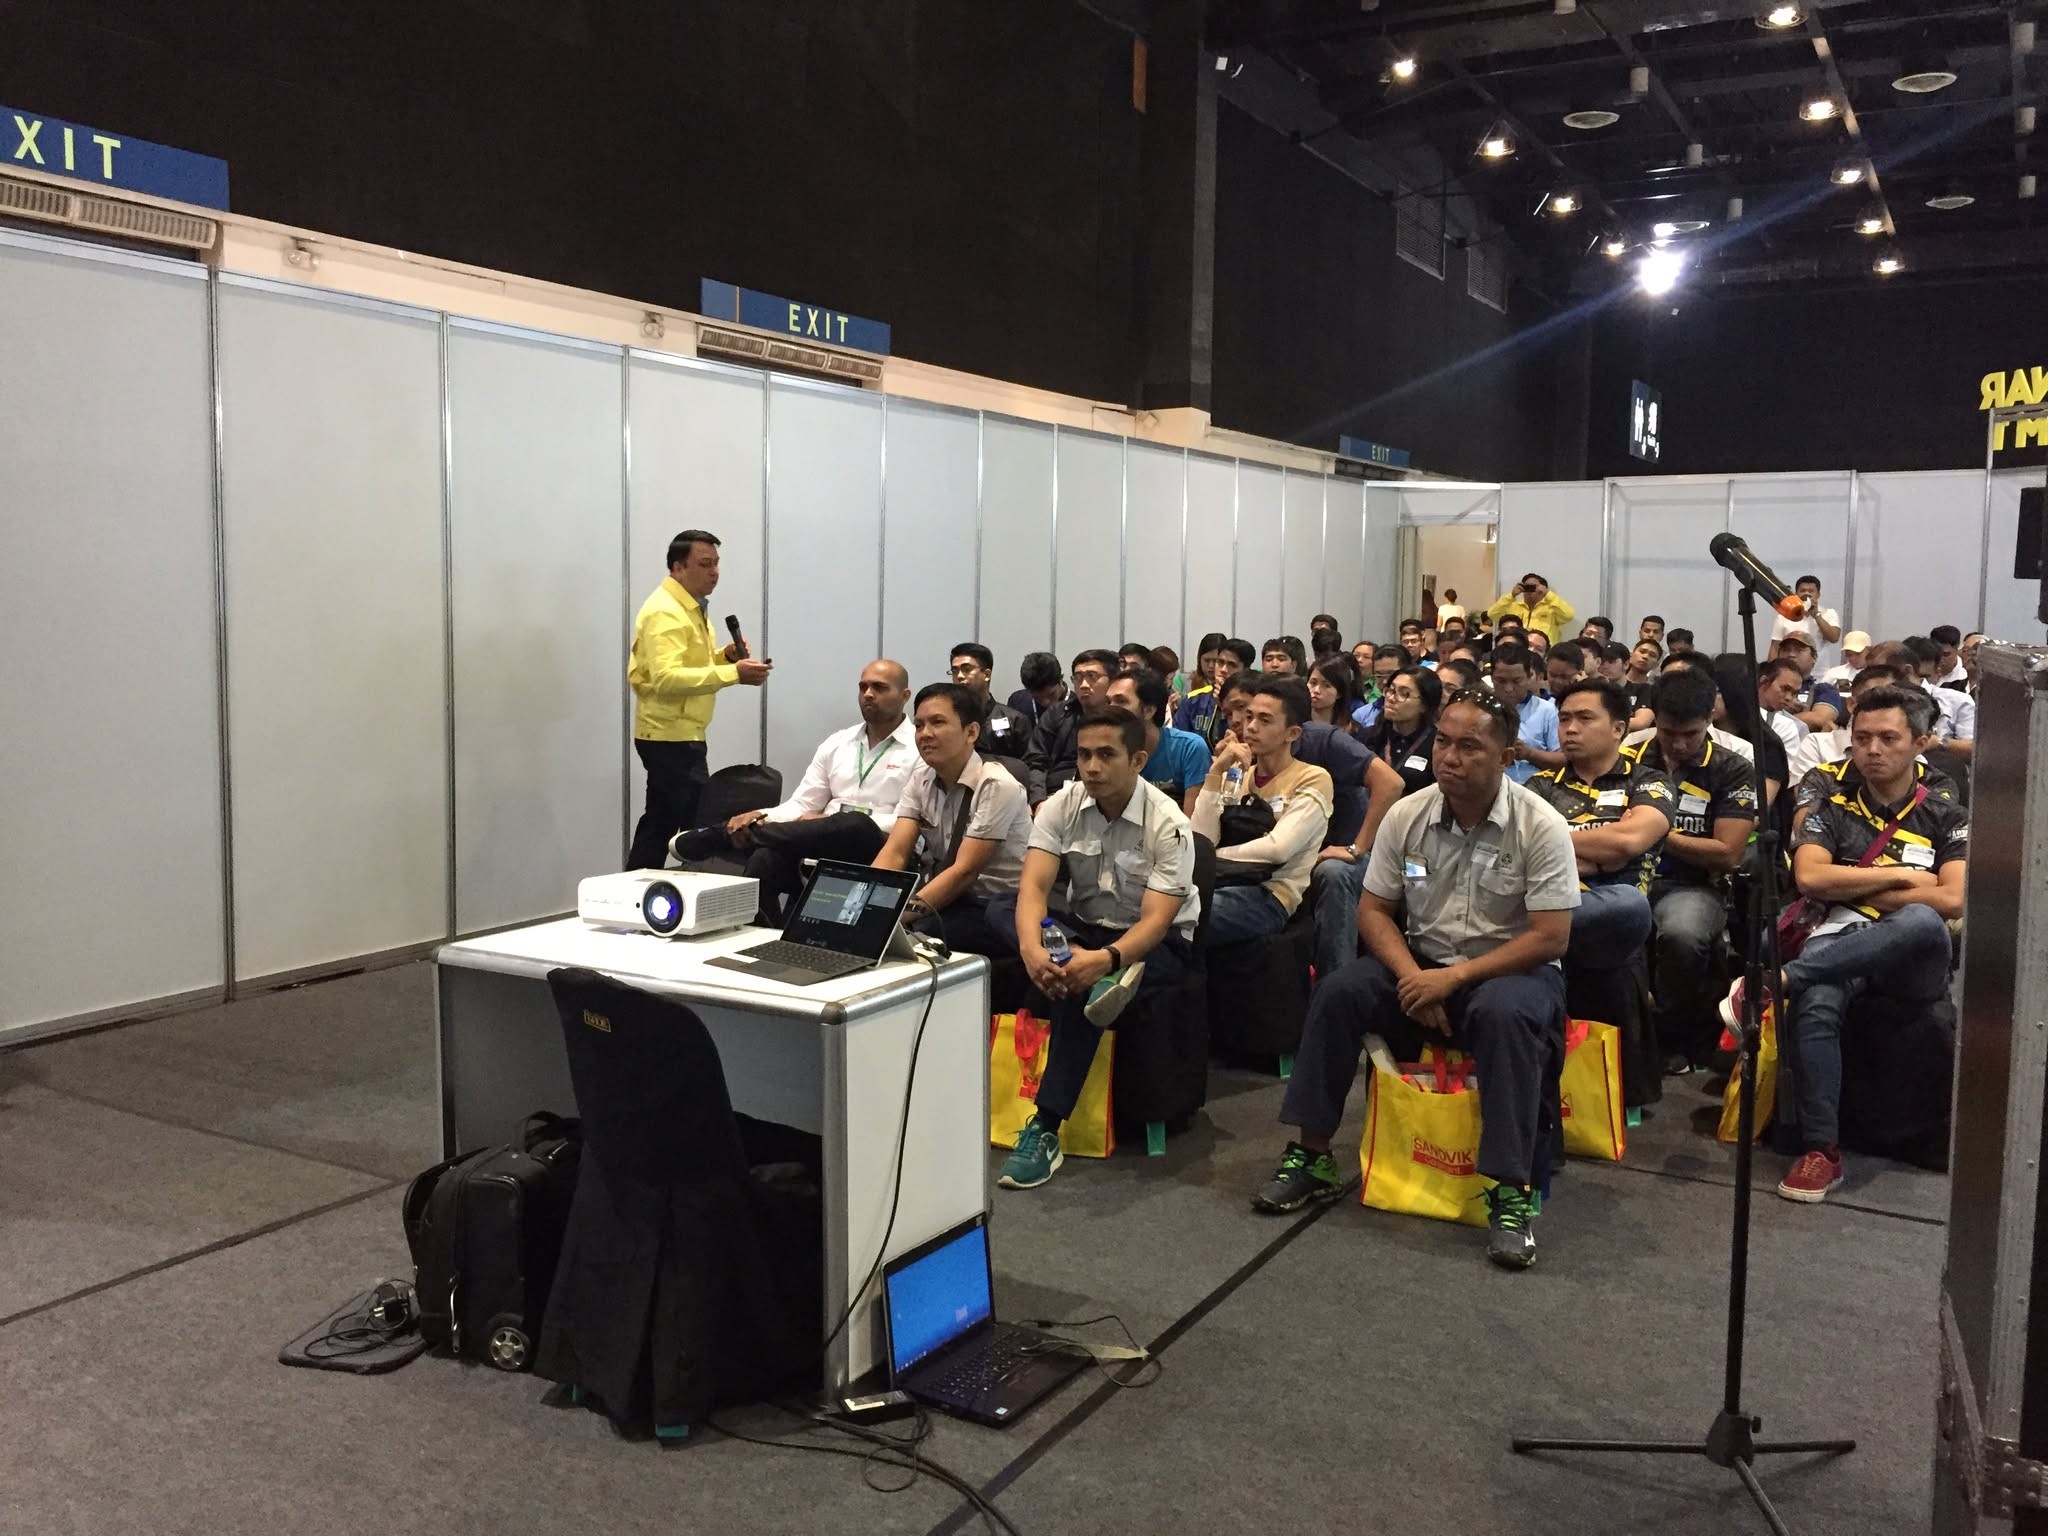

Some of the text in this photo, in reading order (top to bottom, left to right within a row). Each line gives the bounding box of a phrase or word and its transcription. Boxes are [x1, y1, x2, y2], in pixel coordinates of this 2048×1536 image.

[14, 115, 121, 179] XIT
[788, 303, 848, 342] EXIT
[1371, 444, 1390, 462] EXIT
[1414, 1137, 1473, 1164] SANDVIK
